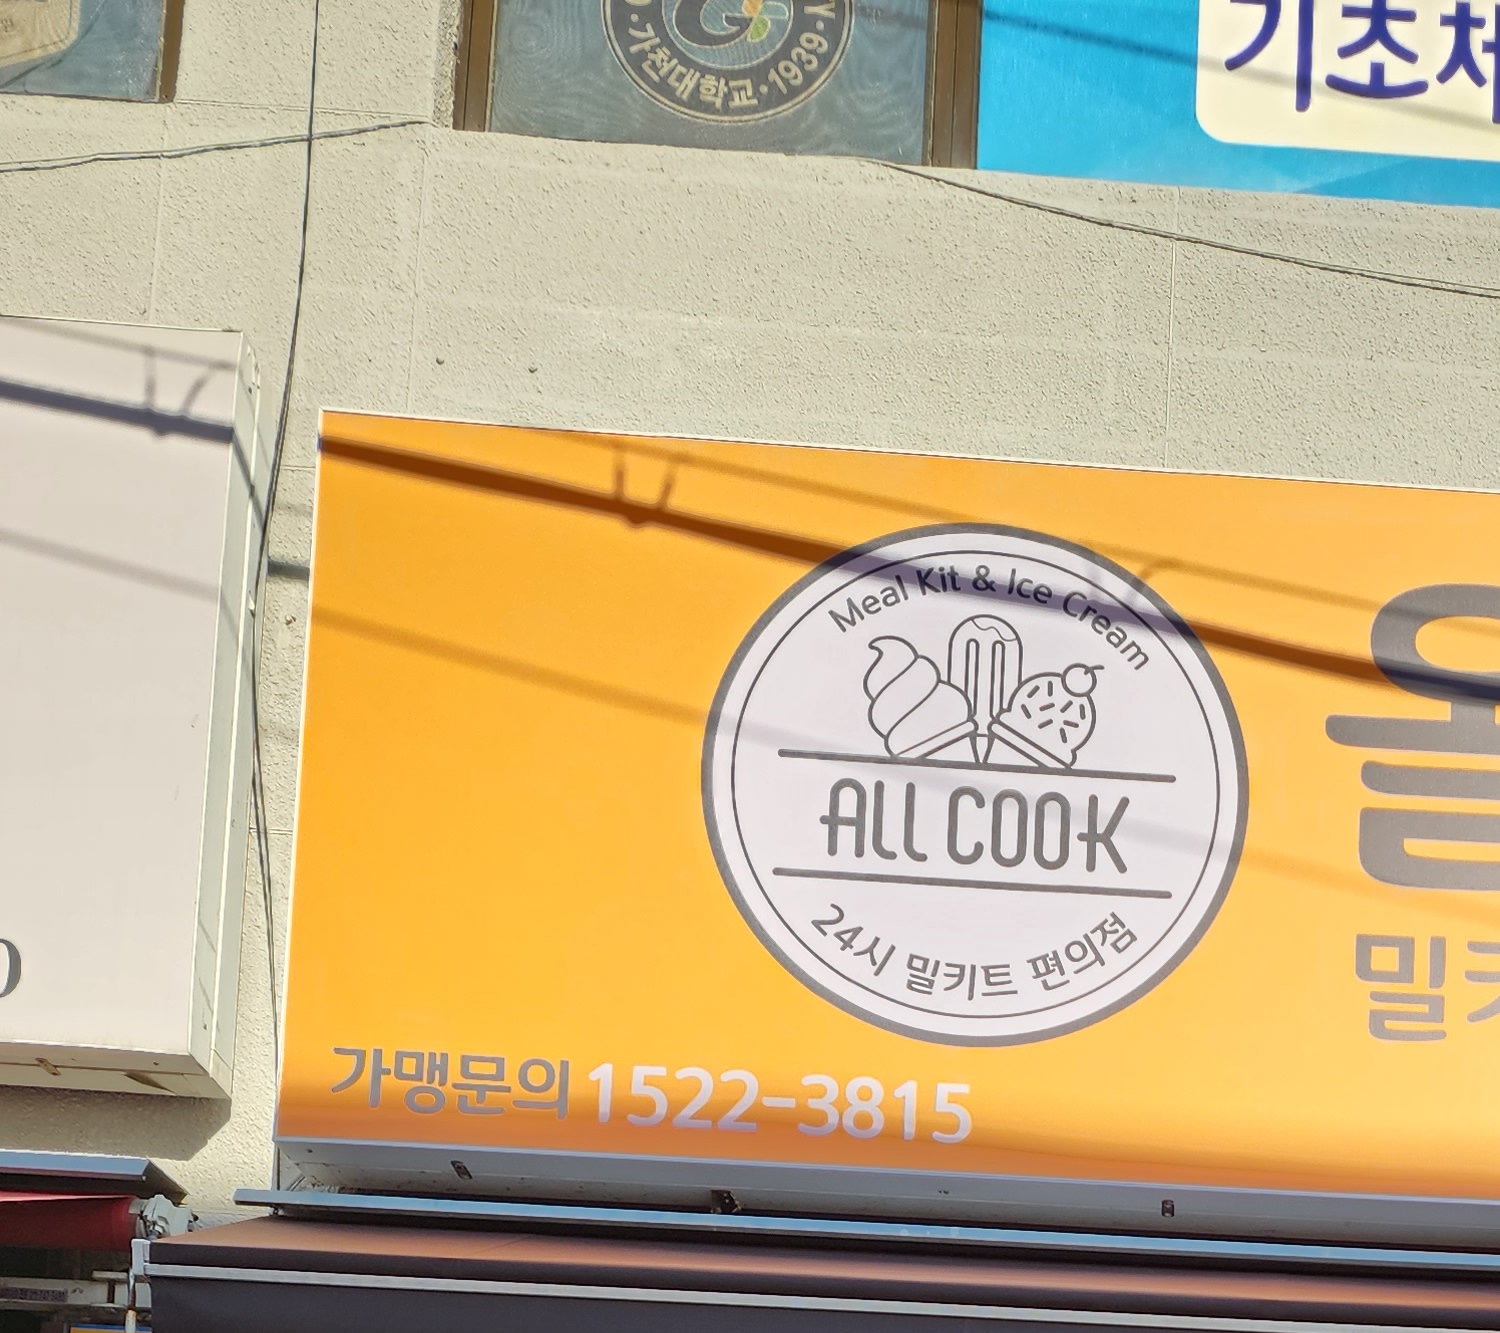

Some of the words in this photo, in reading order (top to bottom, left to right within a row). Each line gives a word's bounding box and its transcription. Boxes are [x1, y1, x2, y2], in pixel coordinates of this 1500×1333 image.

[628, 23, 758, 110] 가천대학교
[767, 32, 829, 95] 1939
[827, 577, 911, 634] Meal
[916, 565, 962, 595] Kit
[972, 565, 997, 592] &
[1006, 567, 1054, 605] Ice
[1061, 590, 1150, 671] Cream
[819, 777, 928, 863] ALL
[945, 785, 1131, 875] COOK
[810, 902, 897, 977] 24시
[906, 953, 1019, 1001] 밀키트
[1027, 911, 1138, 992] 편의점
[331, 1047, 571, 1119] 가맹문의
[588, 1062, 973, 1143] 1522-3815
